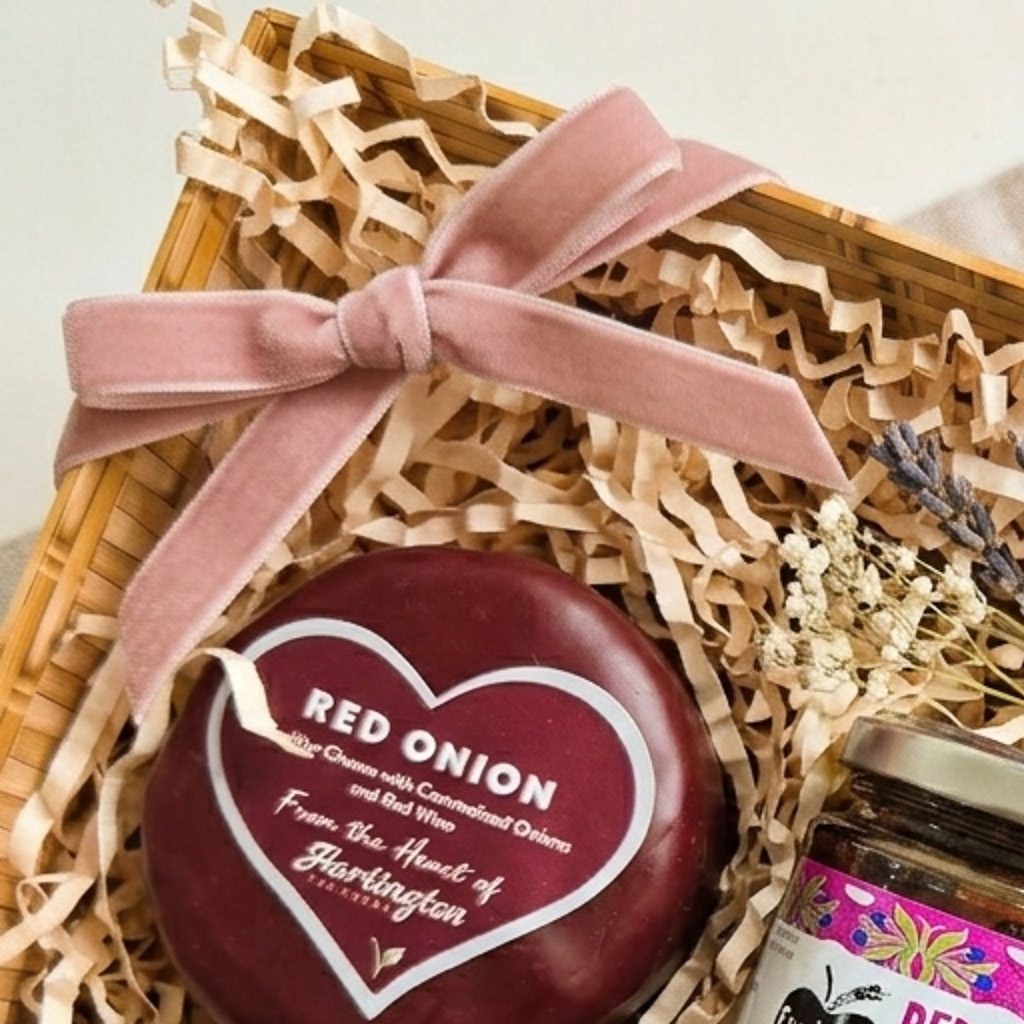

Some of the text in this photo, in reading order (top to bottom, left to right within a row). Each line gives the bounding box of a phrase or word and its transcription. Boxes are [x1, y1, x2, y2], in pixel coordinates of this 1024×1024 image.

[302, 687, 391, 744] RED
[401, 728, 558, 811] ONION
[472, 876, 504, 906] of
